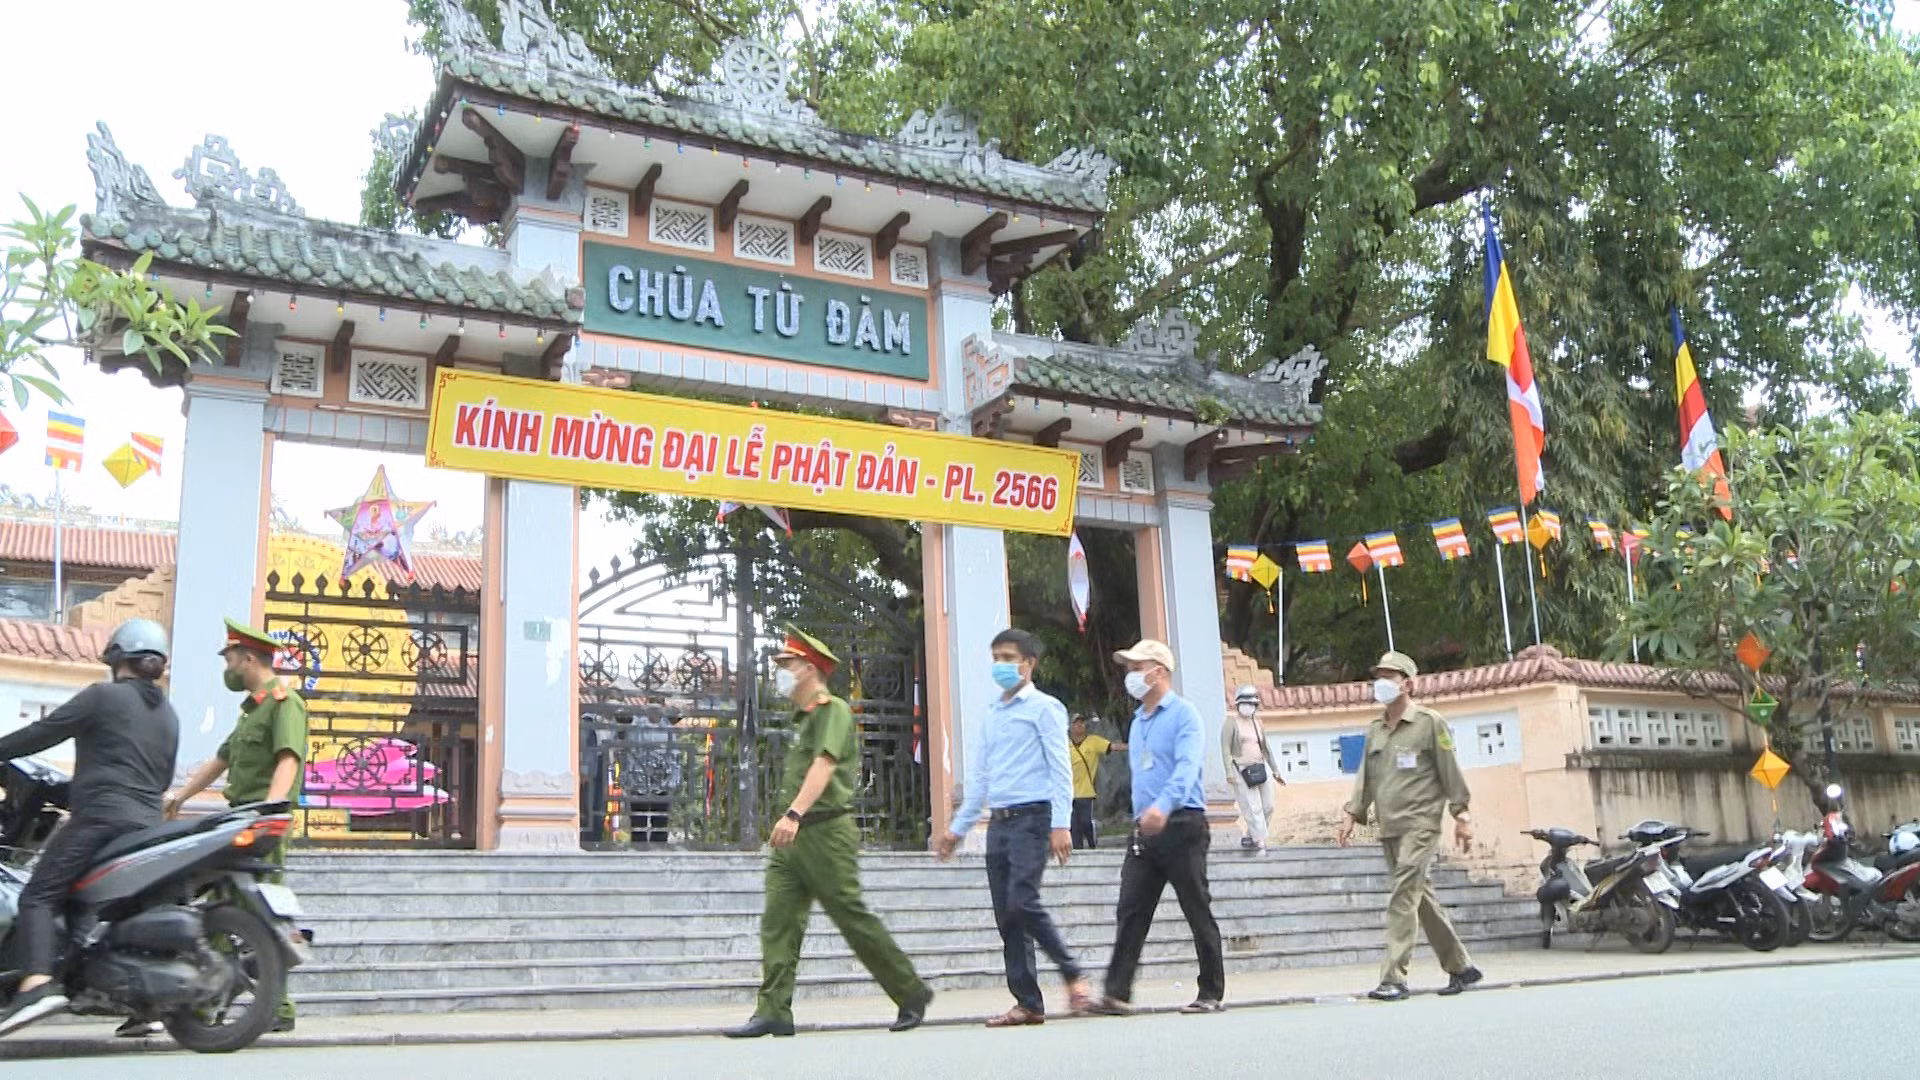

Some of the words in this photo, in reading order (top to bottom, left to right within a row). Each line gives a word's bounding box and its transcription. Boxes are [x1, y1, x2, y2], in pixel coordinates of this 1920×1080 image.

[608, 265, 725, 327] CHÙA
[748, 281, 804, 338] TỪ
[826, 294, 911, 355] ĐÀM
[454, 399, 541, 453] KÍNH
[551, 411, 654, 467] MỪNG
[662, 430, 719, 481] ĐẠI
[726, 426, 764, 478] LỄ
[771, 442, 851, 494] PHẬT
[857, 444, 918, 494] ĐẢN
[943, 464, 984, 503] PL.
[994, 470, 1058, 510] 2566
